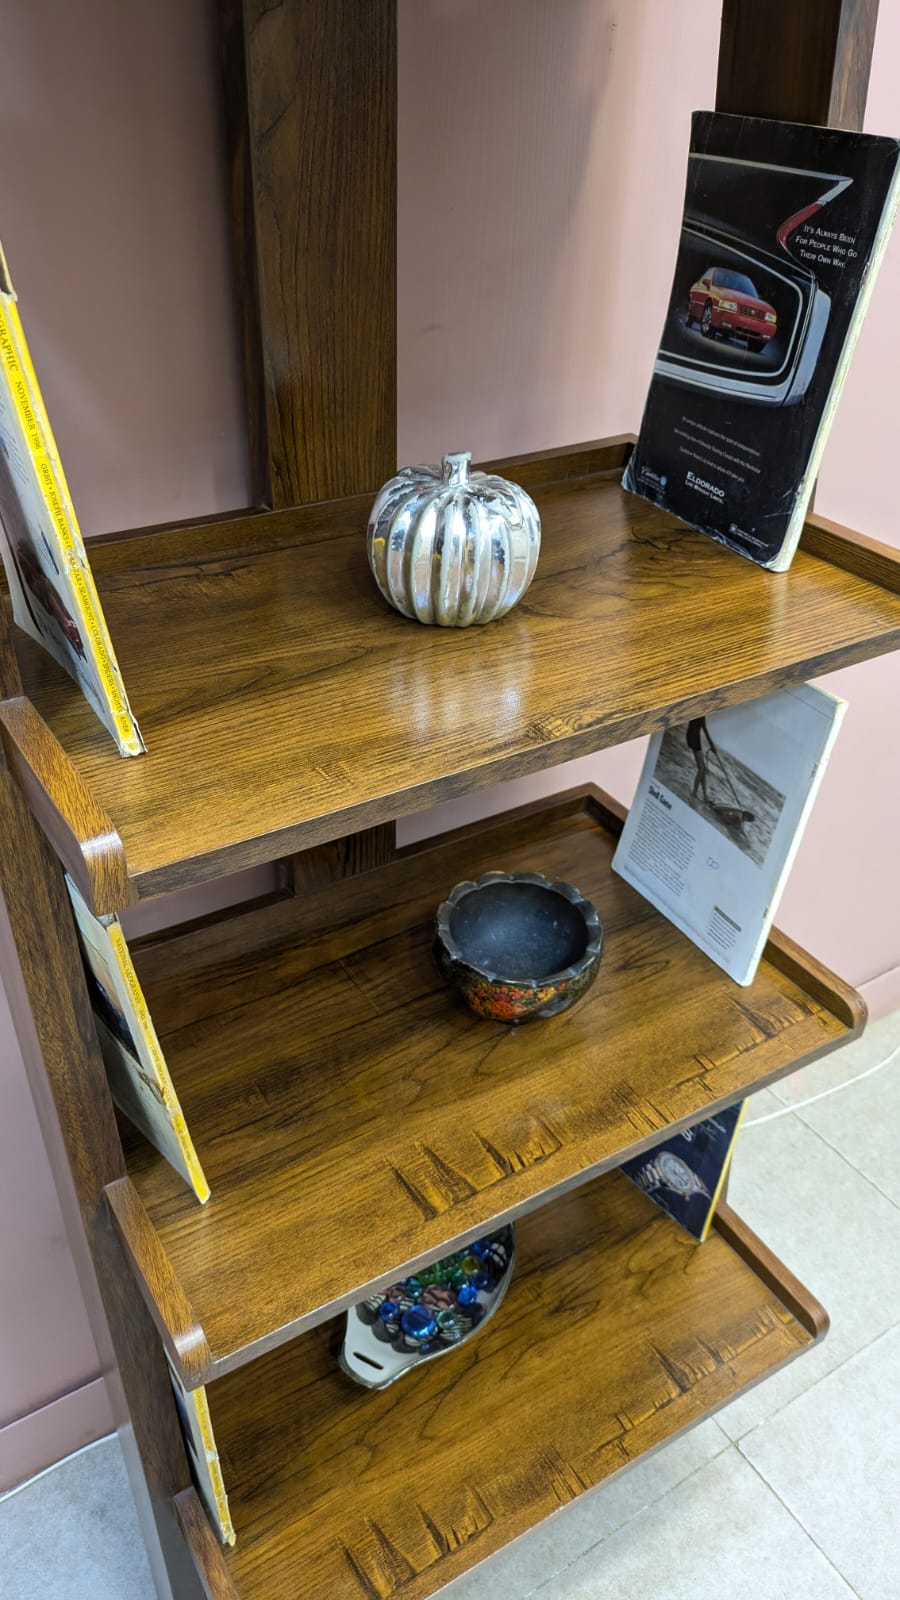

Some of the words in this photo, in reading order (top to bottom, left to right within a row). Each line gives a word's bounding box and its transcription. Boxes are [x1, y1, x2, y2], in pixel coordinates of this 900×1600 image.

[795, 235, 808, 246] FOR
[809, 239, 831, 251] PEOPLE
[832, 245, 846, 255] WHO
[847, 248, 858, 258] GO
[816, 228, 838, 239] ALWAYS
[839, 233, 856, 245] BEEN
[800, 249, 816, 260] THEIR
[817, 255, 831, 264] OWN
[0, 312, 19, 372] GRAPHIC
[15, 381, 36, 431] NOVEMBER
[31, 431, 42, 450] 1996
[686, 471, 725, 497] ELDORADO
[41, 463, 54, 486] ORBIT
[49, 490, 62, 515] JOSEPH
[58, 514, 70, 542] BANKS
[78, 586, 94, 622] SEAMOUNT
[91, 624, 106, 660] COLORADO
[102, 662, 114, 688] SPIDERS
[119, 715, 130, 734] RIVER
